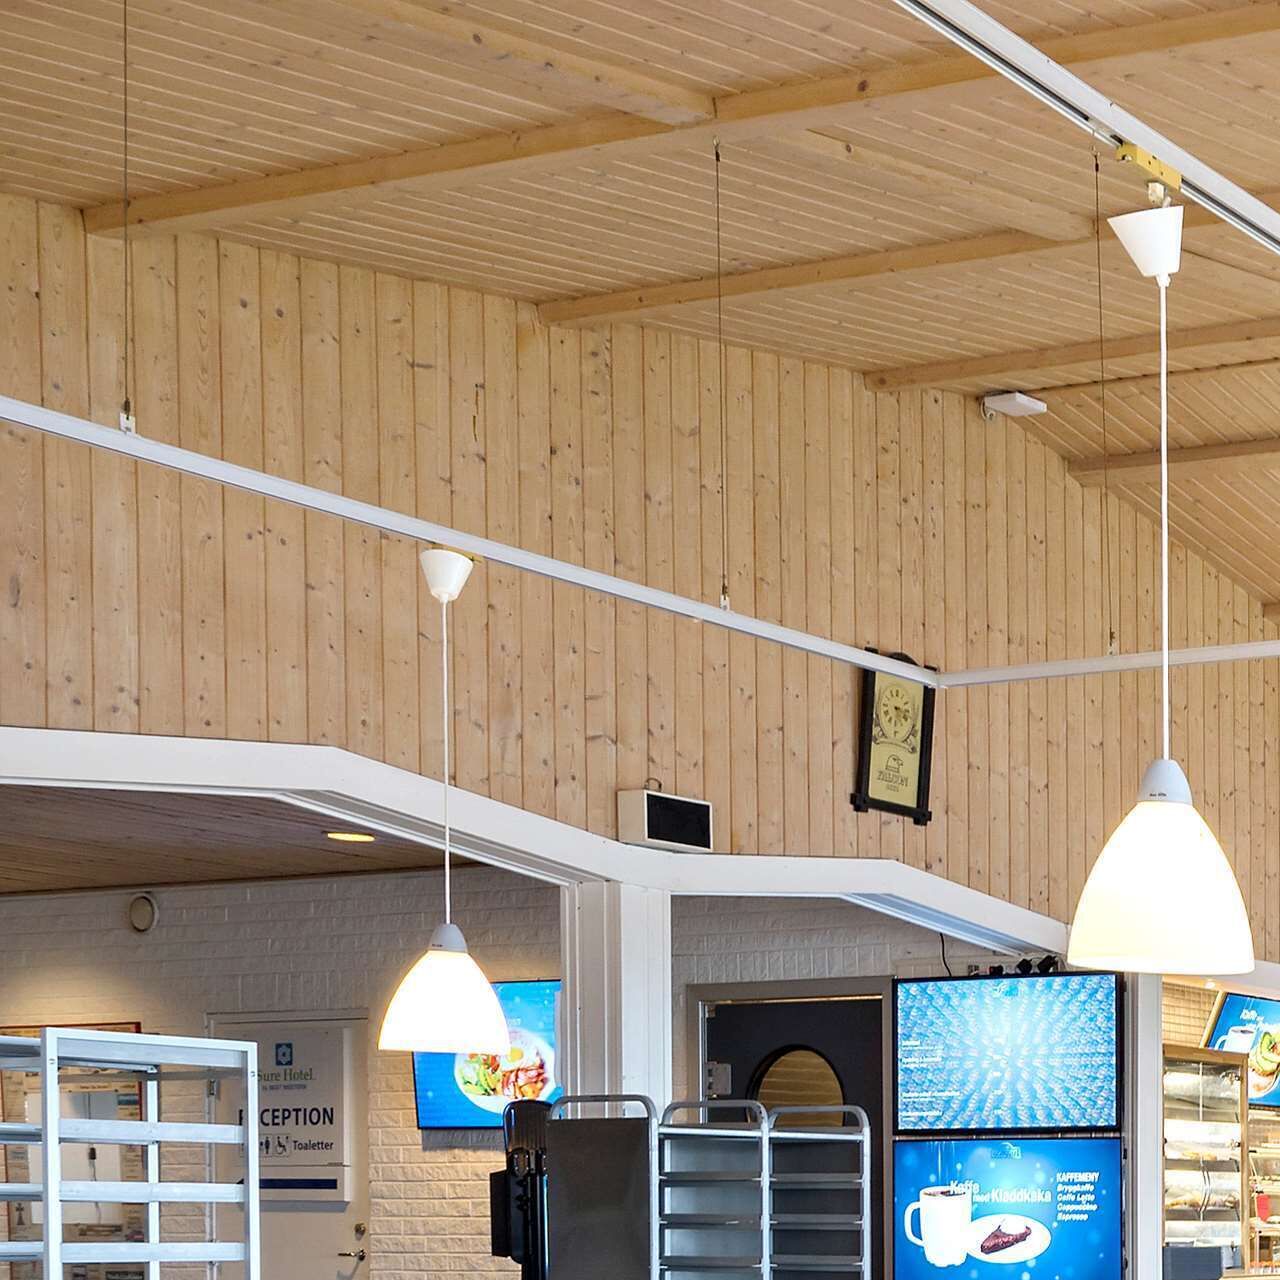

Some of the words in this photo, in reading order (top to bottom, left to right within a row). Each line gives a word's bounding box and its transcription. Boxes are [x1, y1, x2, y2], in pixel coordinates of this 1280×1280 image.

[258, 1069, 280, 1081] Sure
[284, 1068, 312, 1081] Hotel
[239, 1107, 334, 1126] CEPTION
[293, 1139, 333, 1151] Toaletter
